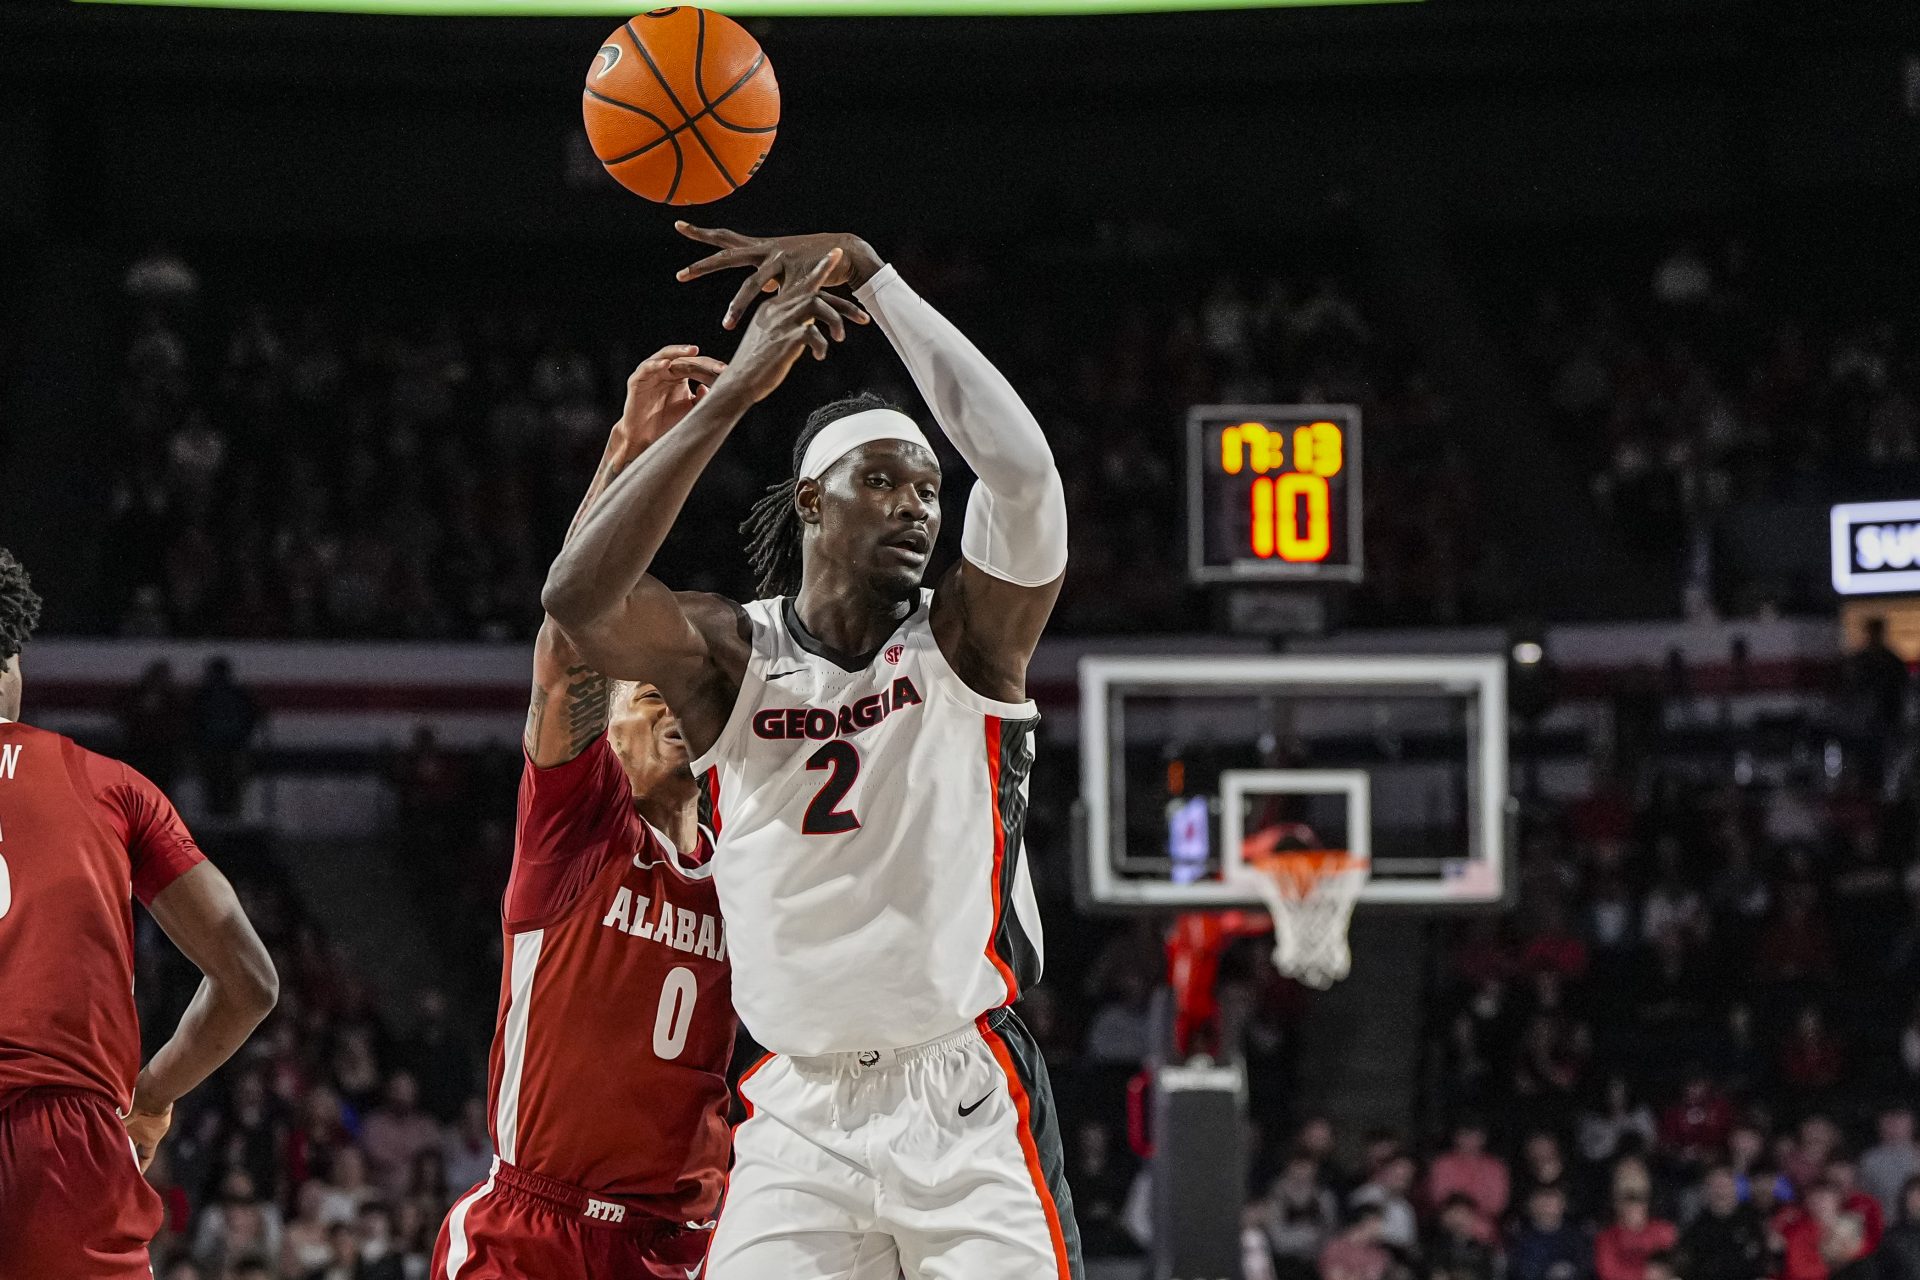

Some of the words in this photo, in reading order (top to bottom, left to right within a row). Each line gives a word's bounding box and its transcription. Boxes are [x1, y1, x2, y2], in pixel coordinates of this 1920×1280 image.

[1252, 472, 1329, 562] 10
[752, 675, 923, 741] GEORGIA
[802, 739, 862, 835] 2
[653, 966, 698, 1060] 0
[583, 1198, 626, 1223] RTR
